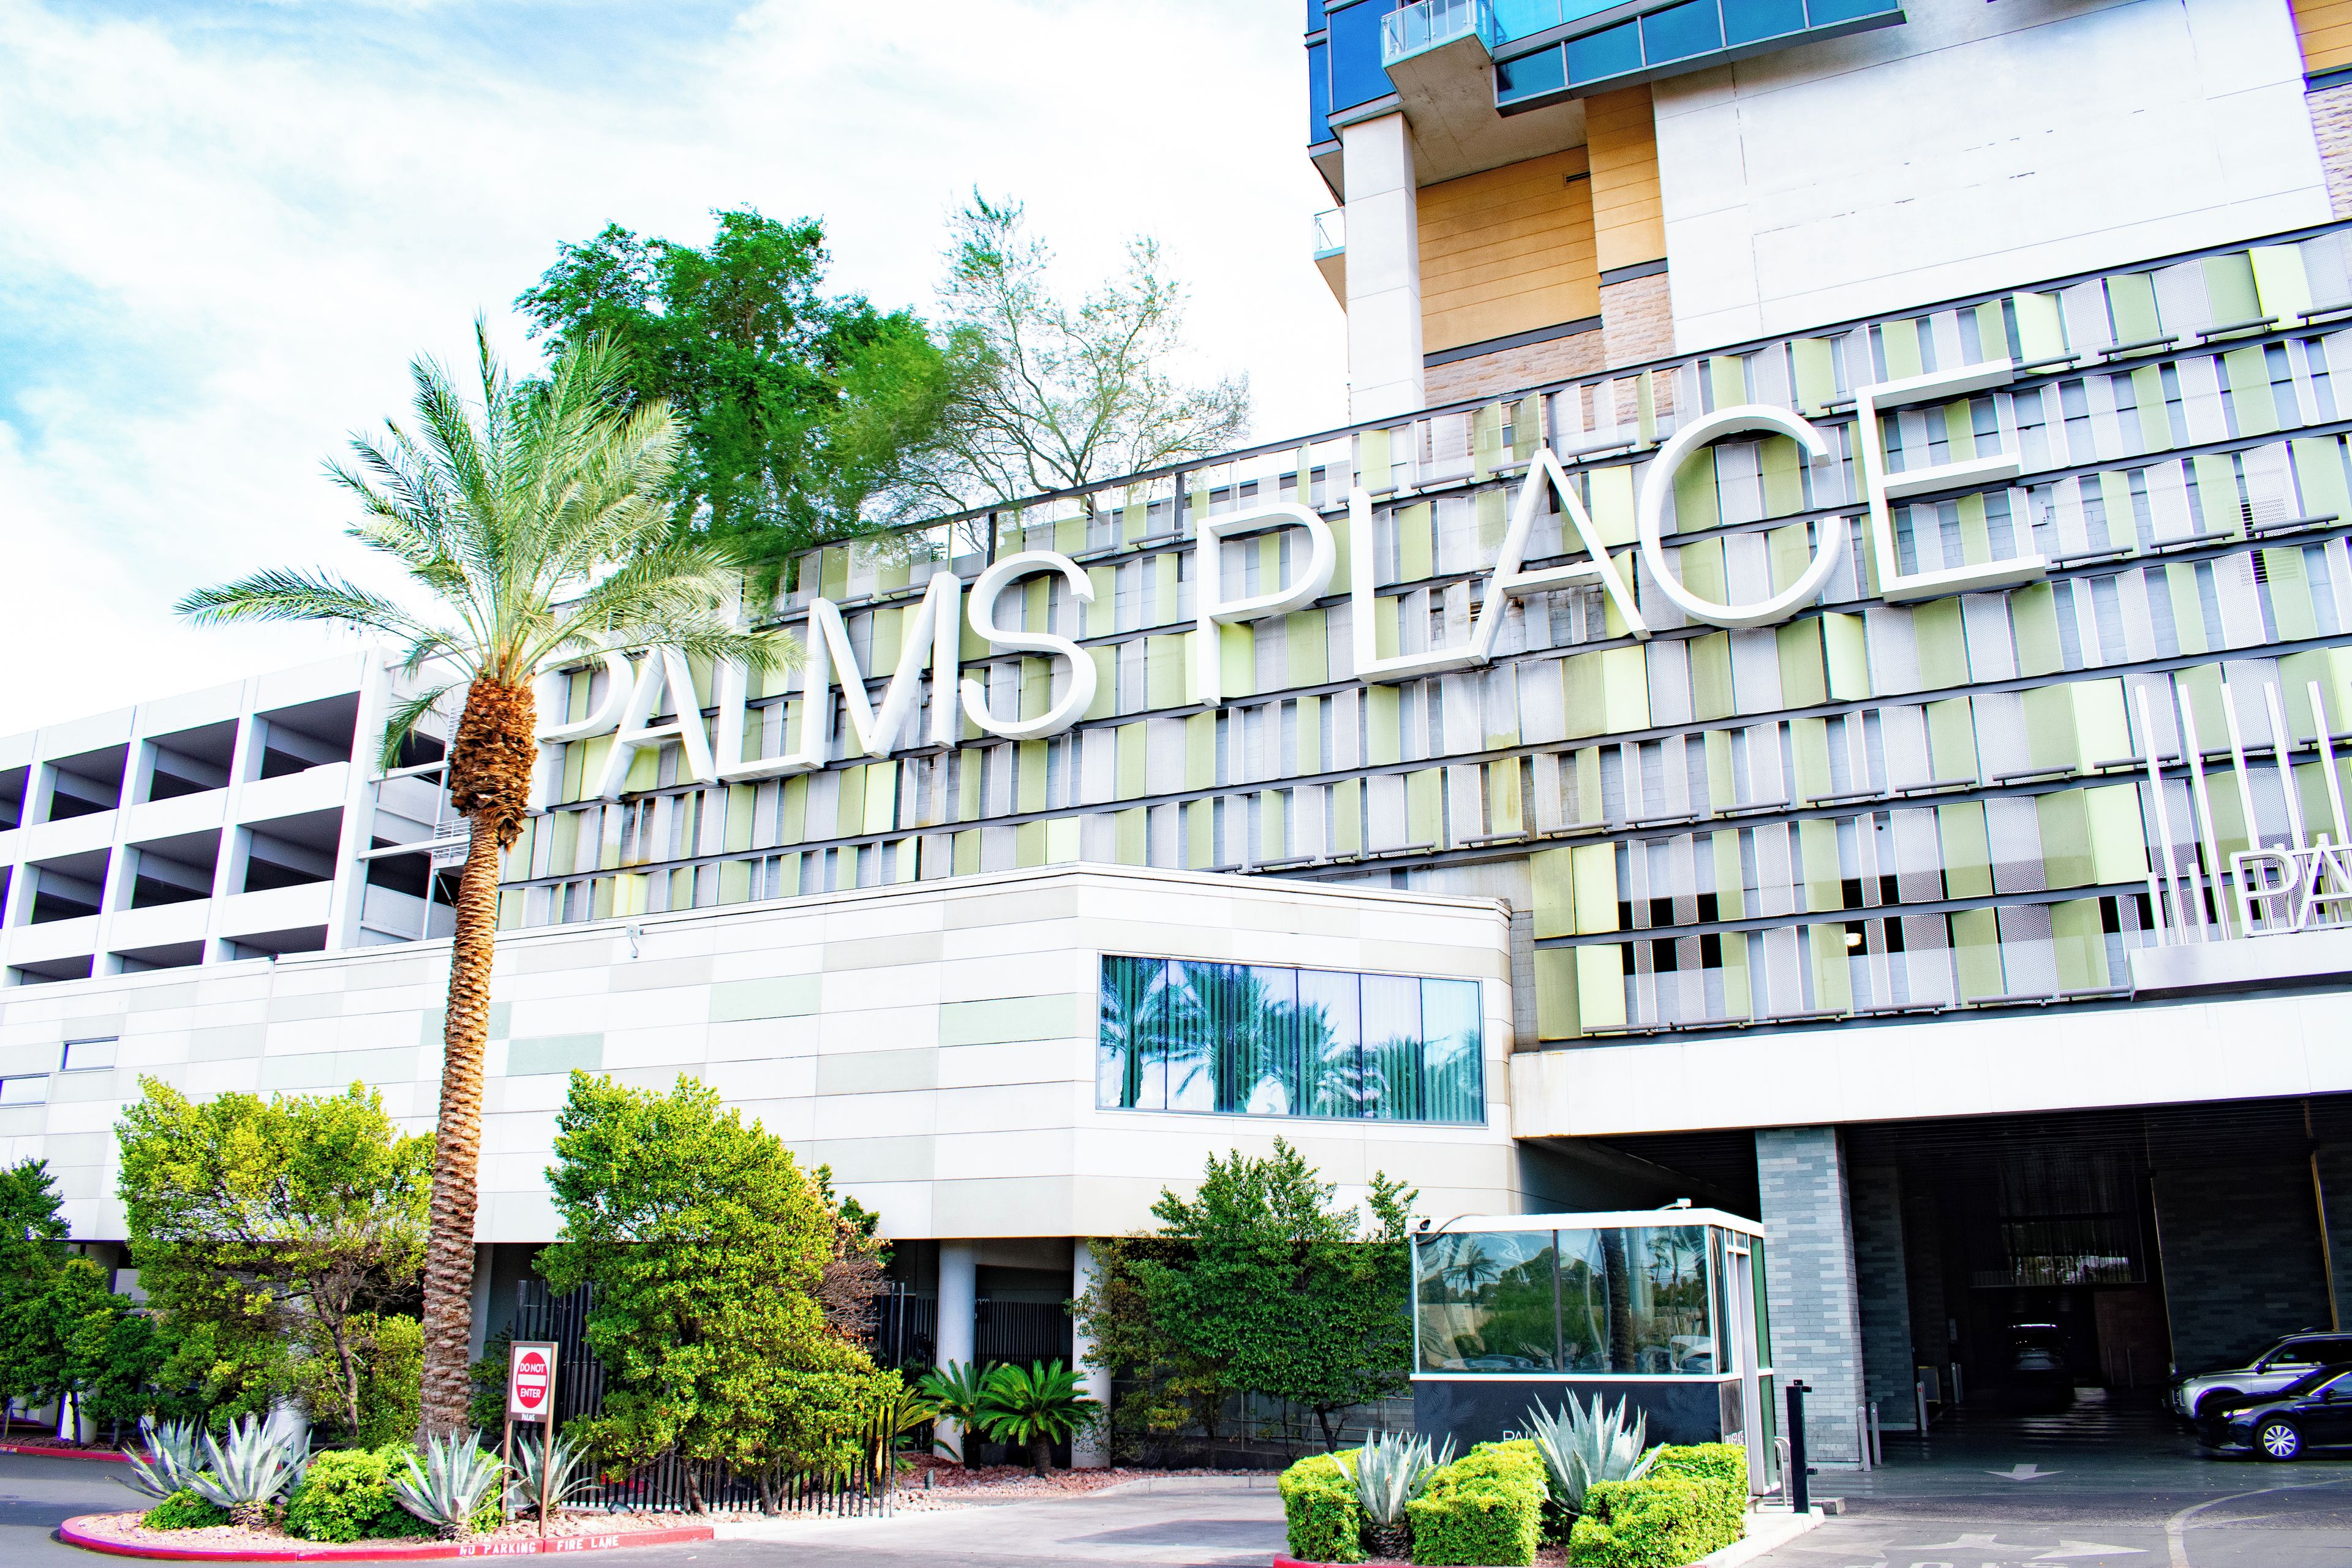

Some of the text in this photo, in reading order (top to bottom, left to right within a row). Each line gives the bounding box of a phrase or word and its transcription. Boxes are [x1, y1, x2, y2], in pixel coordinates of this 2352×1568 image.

[527, 358, 2047, 812] PALMS PLACE
[519, 1363, 545, 1373] DO NOT
[520, 1388, 541, 1398] ENTER
[459, 1535, 619, 1556] NO PARKING FIRE LANE
